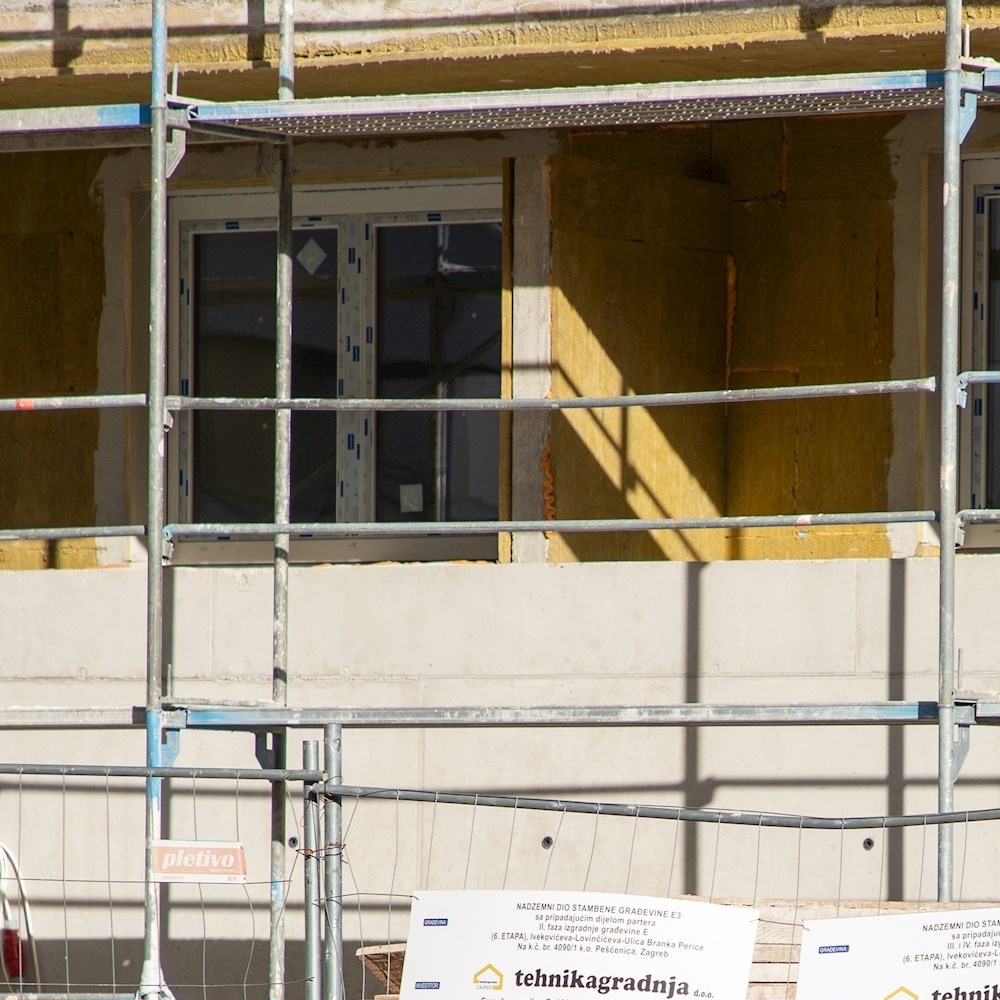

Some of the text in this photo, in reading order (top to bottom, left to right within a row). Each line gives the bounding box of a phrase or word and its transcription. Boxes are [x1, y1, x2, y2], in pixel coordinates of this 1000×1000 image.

[162, 849, 235, 870] pletivo
[516, 903, 555, 911] NADZEMNI
[556, 903, 570, 911] DIO
[572, 904, 616, 914] STAMBENE
[671, 911, 681, 919] E3
[595, 915, 625, 925] dijelom
[626, 919, 656, 927] partera
[922, 922, 964, 932] NADZEMNI
[966, 921, 980, 929] DIO
[547, 923, 563, 931] faza
[564, 923, 599, 934] izgradnje
[647, 938, 676, 948] Branka
[678, 941, 704, 951] Perice
[640, 948, 669, 958] Zagreb
[903, 955, 912, 964] (6.
[515, 968, 689, 999] tehnikagradnja
